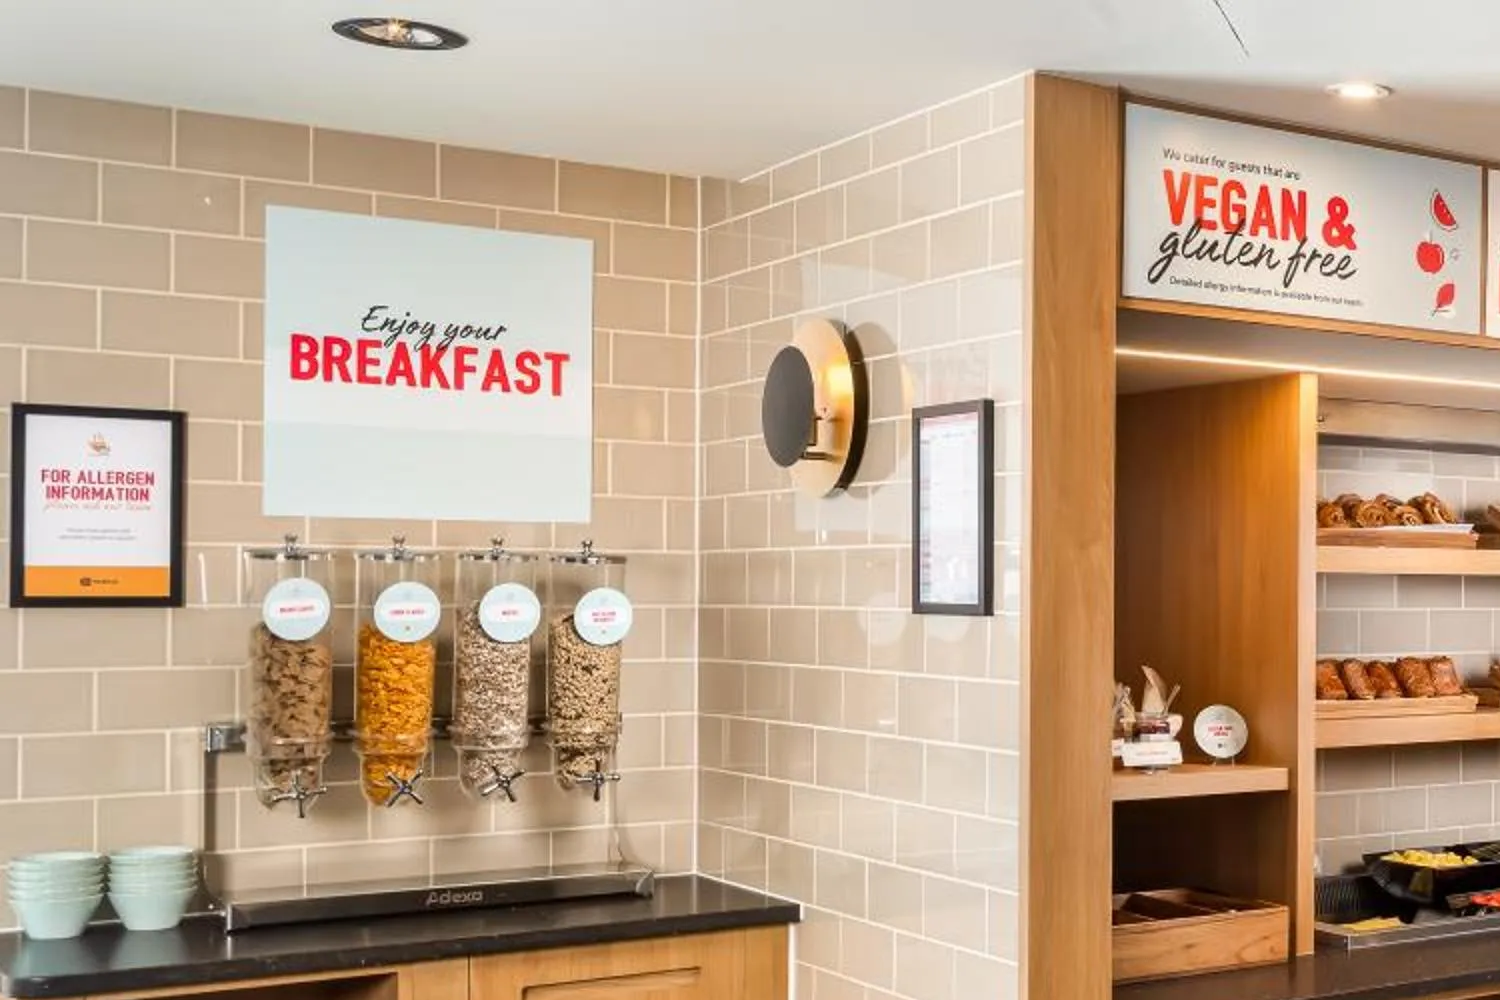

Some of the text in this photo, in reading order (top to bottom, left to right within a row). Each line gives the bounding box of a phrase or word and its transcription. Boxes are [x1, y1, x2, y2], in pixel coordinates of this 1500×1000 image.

[1163, 147, 1300, 180] We cater for guests that are
[1162, 169, 1357, 250] VEGAN &
[1147, 216, 1357, 288] gluten free
[361, 305, 507, 352] Enjoy your
[289, 333, 571, 397] BREAKFAST
[40, 469, 155, 486] FOR ALLERGEN
[45, 485, 150, 502] INFORMATION
[425, 890, 484, 907] Adexa
